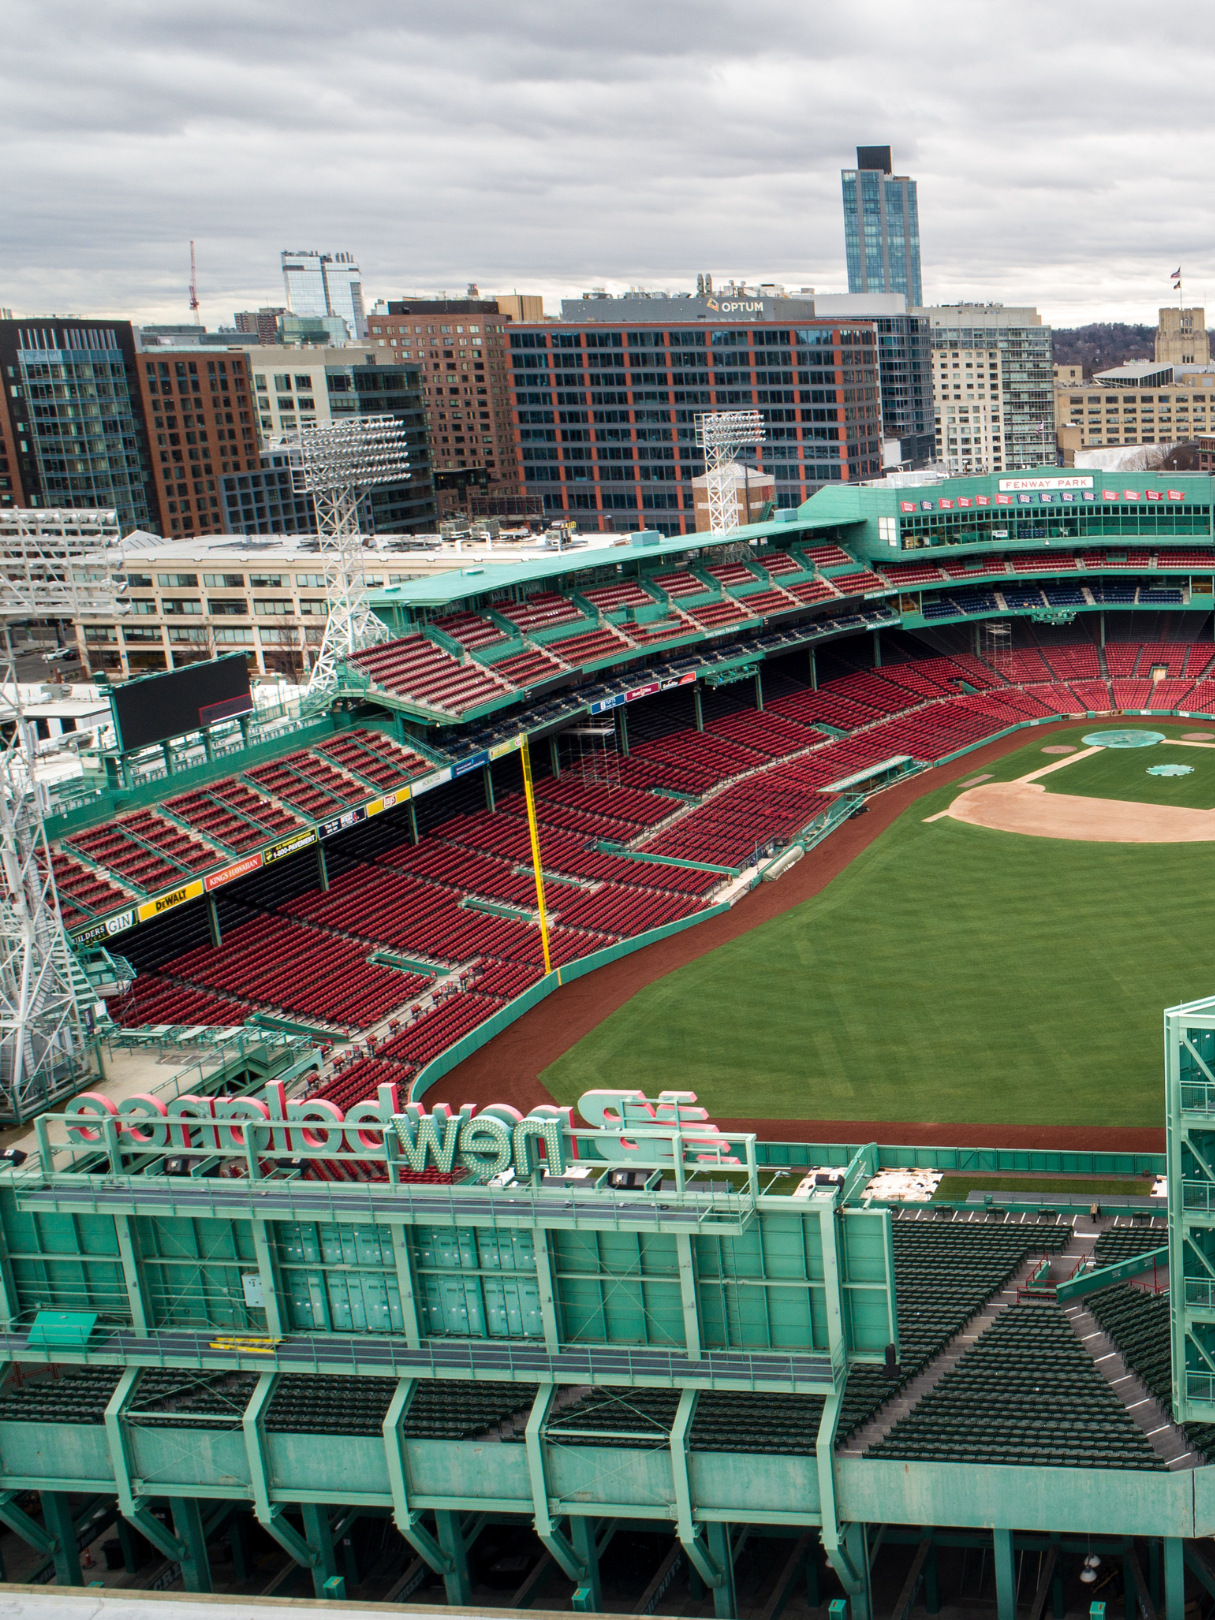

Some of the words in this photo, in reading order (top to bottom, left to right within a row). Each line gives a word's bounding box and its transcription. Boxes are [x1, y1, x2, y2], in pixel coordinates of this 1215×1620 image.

[721, 302, 764, 312] OPTUM
[1006, 479, 1051, 489] FENWAY
[1057, 478, 1088, 487] PARK
[229, 857, 259, 878] HAWAIIAN
[107, 913, 131, 934] GIN
[72, 924, 105, 944] UILDERS
